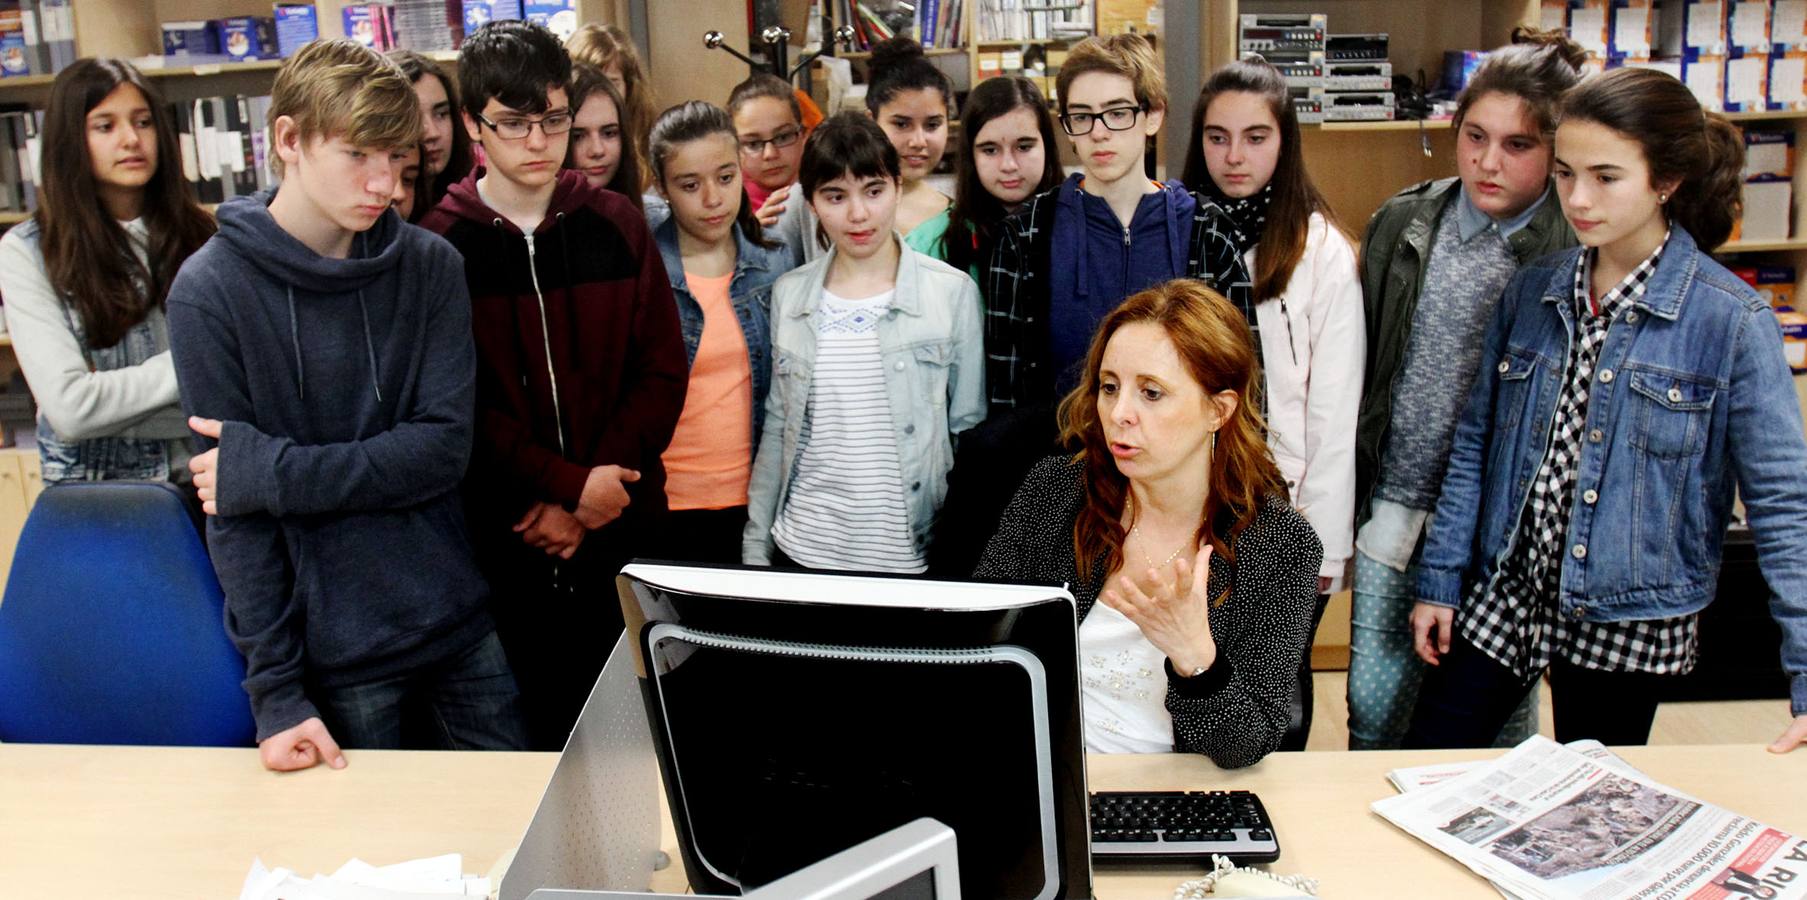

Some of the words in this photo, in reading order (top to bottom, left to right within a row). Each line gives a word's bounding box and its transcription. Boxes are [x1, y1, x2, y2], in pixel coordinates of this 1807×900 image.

[1715, 816, 1744, 841] reclama
[1692, 839, 1721, 862] 10.000
[1705, 838, 1741, 865] González
[1661, 872, 1676, 884] por
[1672, 859, 1696, 876] euros
[1676, 863, 1711, 889] denuncia
[1740, 866, 1798, 900] RIO
